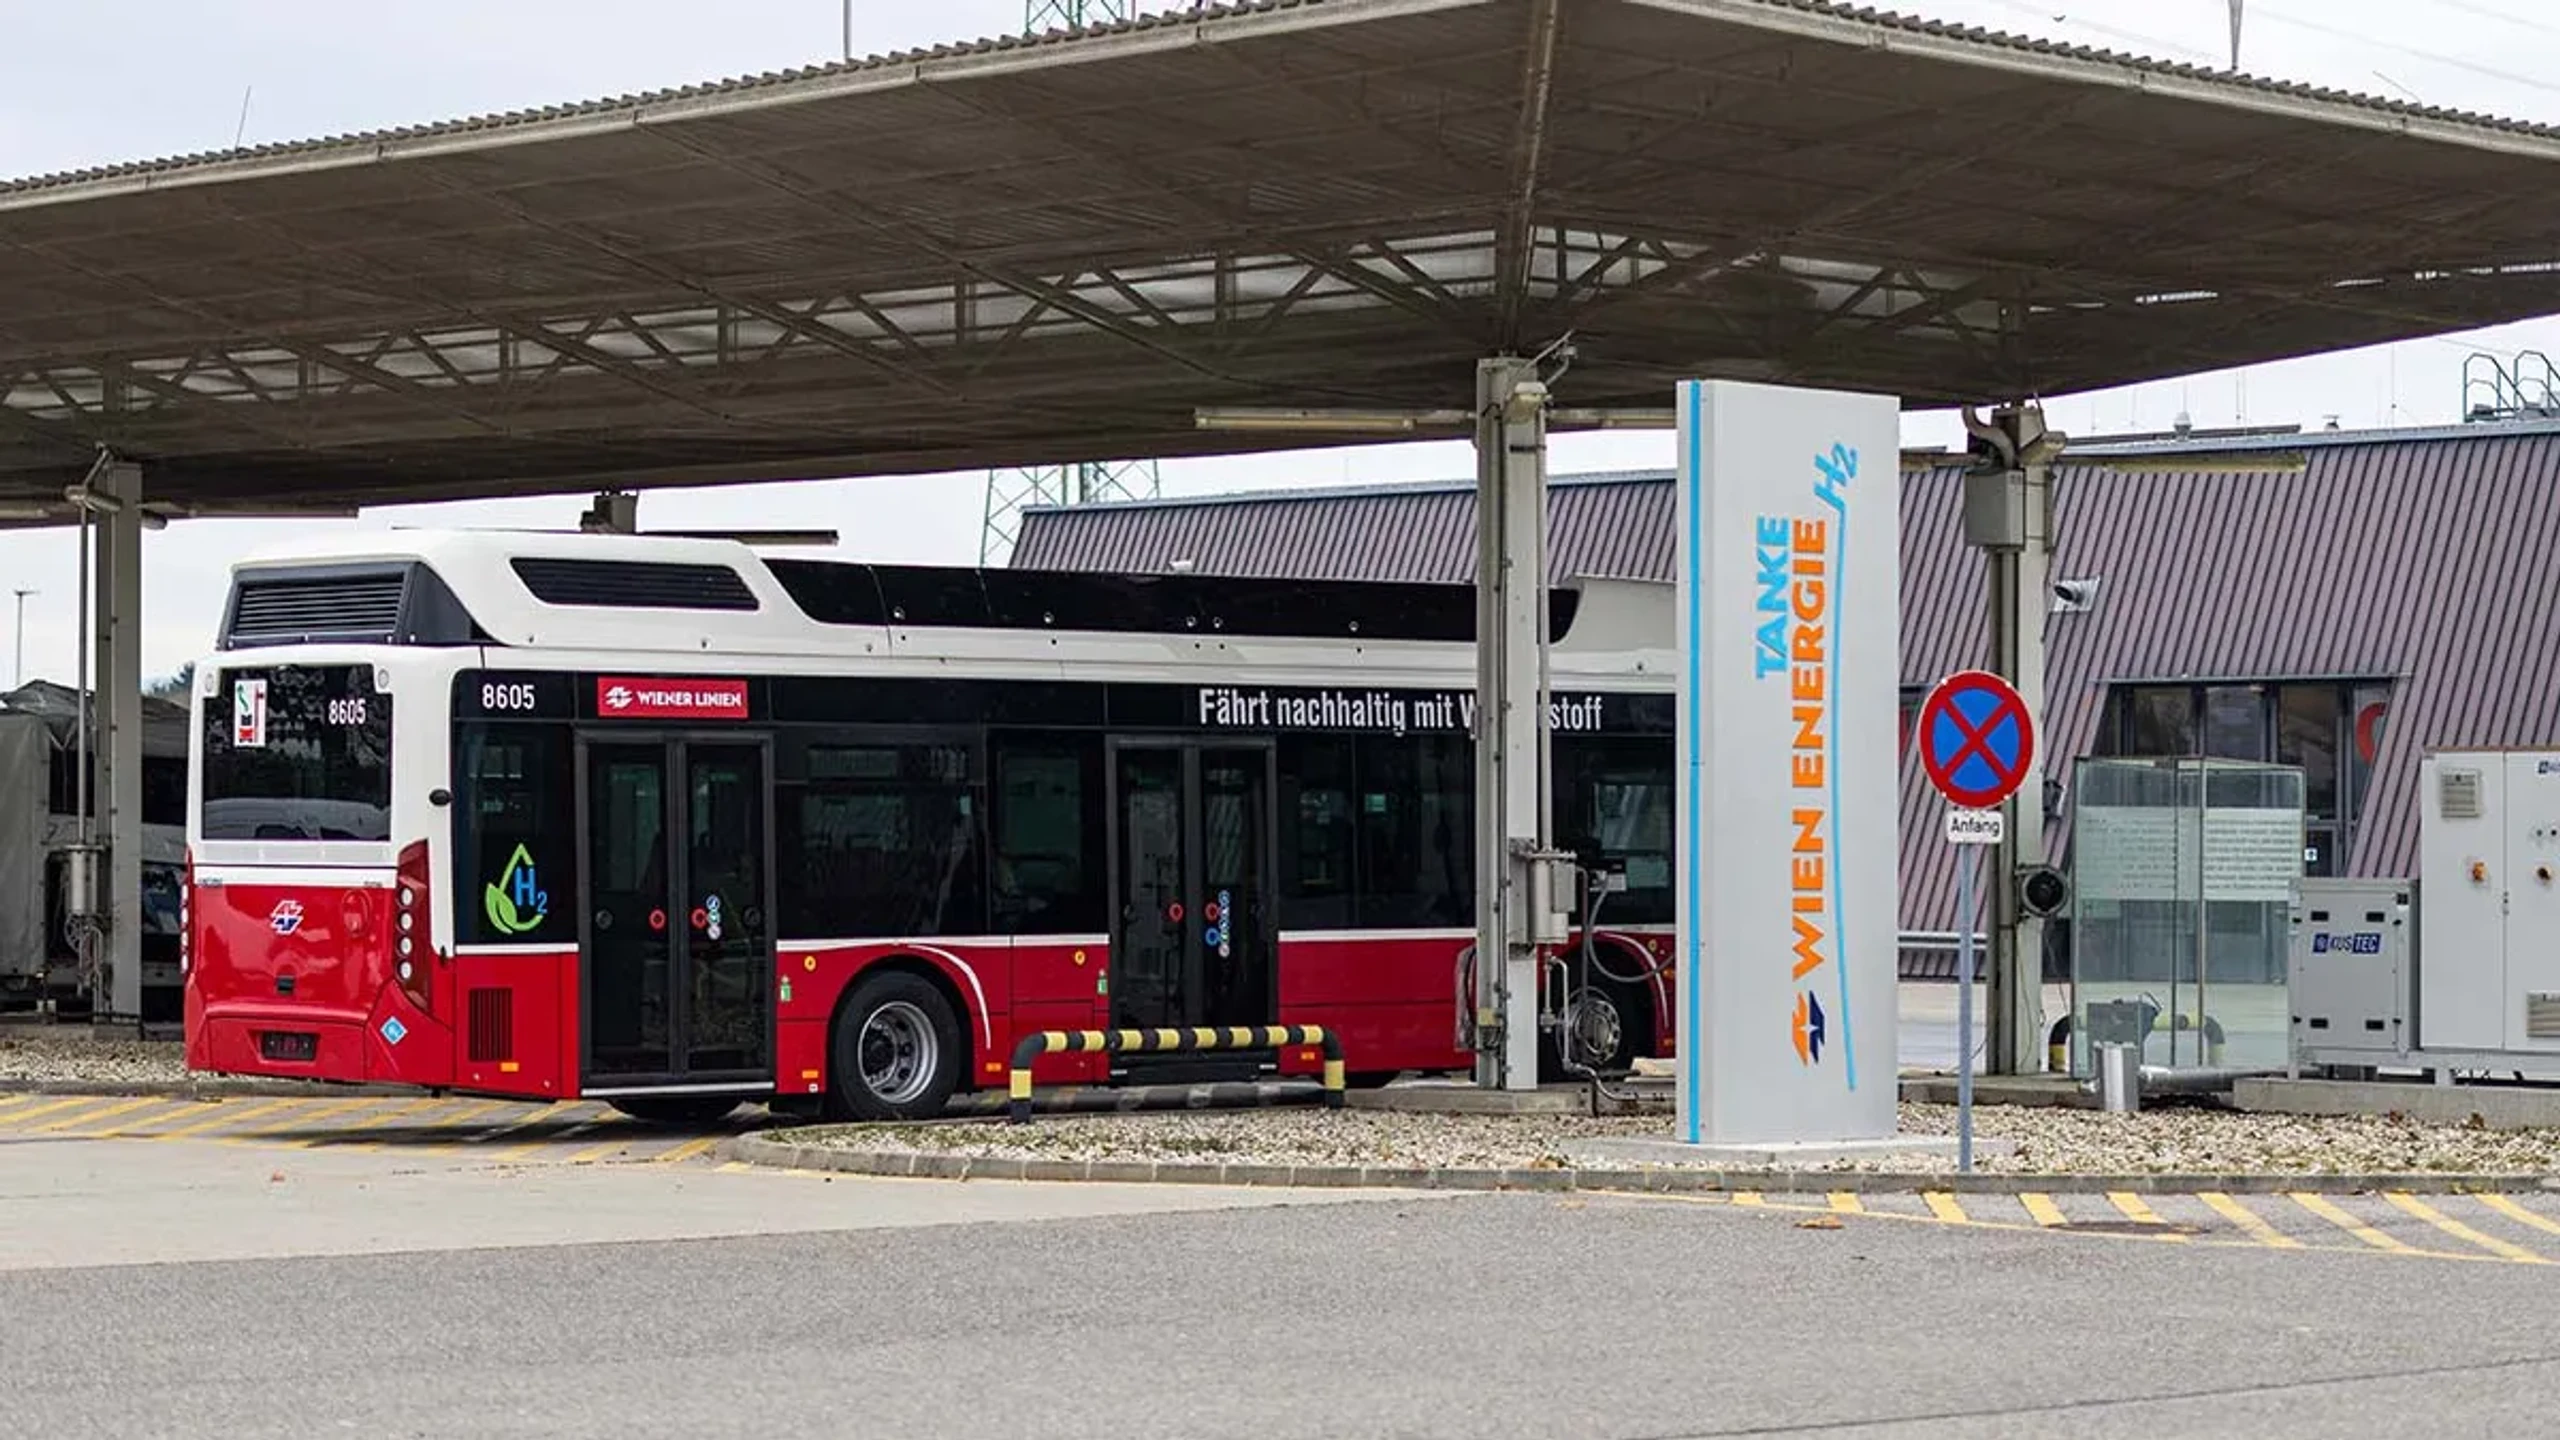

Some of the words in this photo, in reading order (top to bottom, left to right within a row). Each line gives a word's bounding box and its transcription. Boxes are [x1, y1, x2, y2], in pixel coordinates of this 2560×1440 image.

[1813, 441, 1858, 513] H2
[1756, 514, 1790, 680] TANKE
[1791, 518, 1826, 788] ENERGIE
[328, 698, 366, 725] 8605
[481, 683, 535, 710] 8605
[636, 690, 693, 708] WIENER
[695, 691, 742, 708] LINIEN
[1199, 688, 1270, 726] Fährt
[1276, 690, 1406, 738] nachhaltig
[1414, 693, 1454, 728] mit
[1950, 817, 2001, 837] Anfang
[514, 866, 548, 914] H2
[1791, 809, 1826, 983] WIEN
